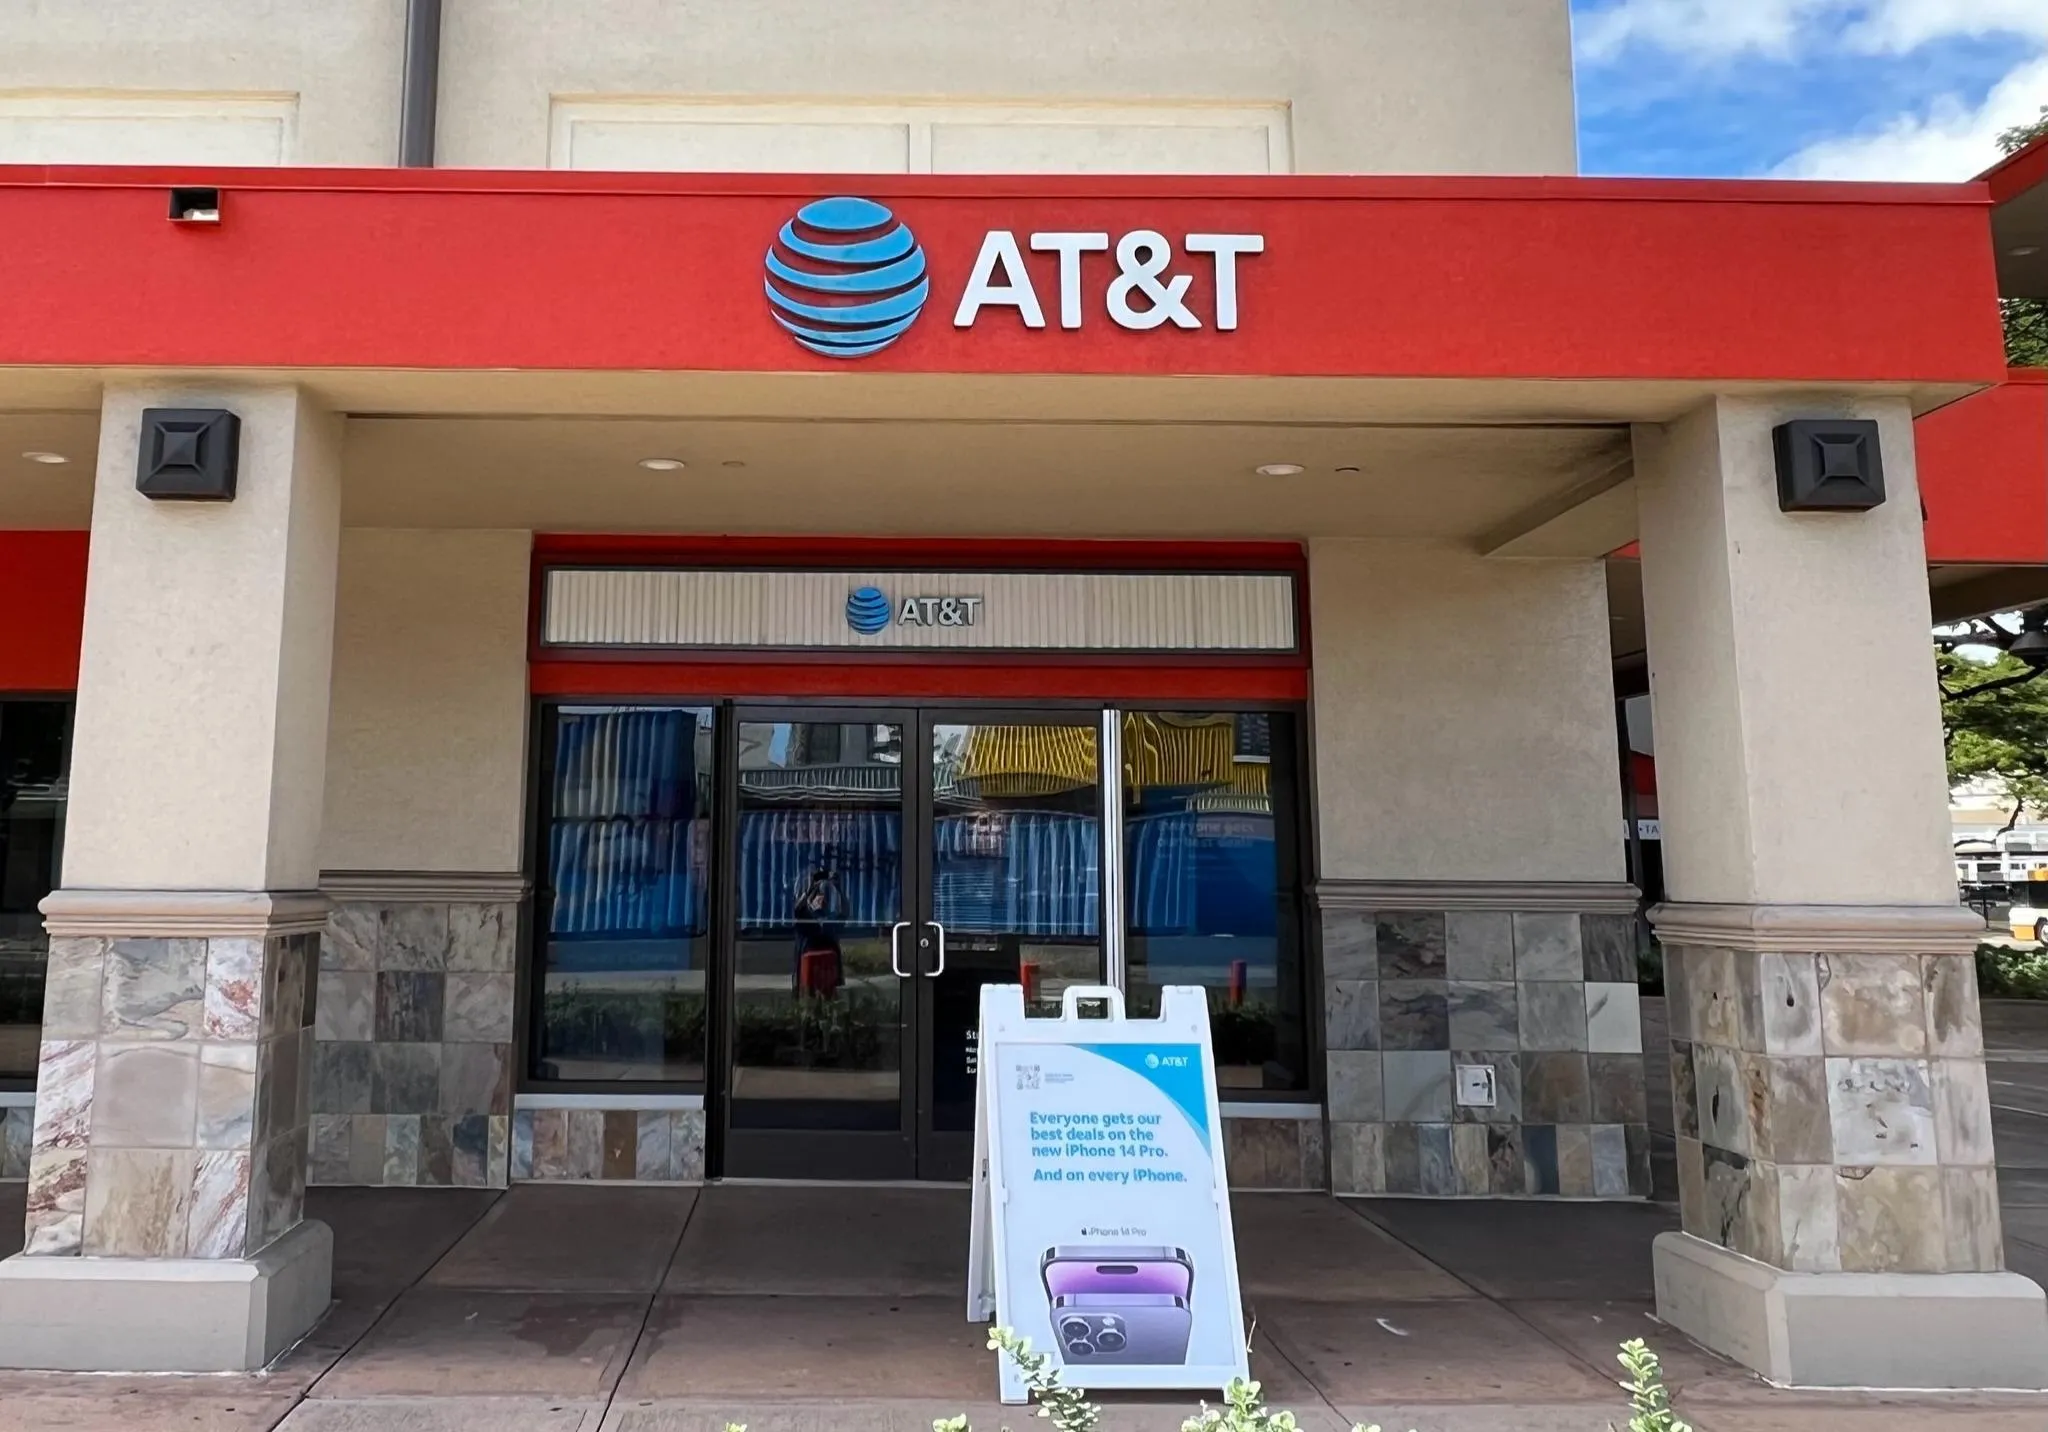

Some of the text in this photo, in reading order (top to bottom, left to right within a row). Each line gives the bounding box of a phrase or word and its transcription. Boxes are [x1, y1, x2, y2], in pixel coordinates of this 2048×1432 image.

[954, 229, 1265, 332] AT&T
[897, 594, 982, 627] AT&T
[1162, 1056, 1189, 1068] AT&T
[1030, 1111, 1161, 1127] Everyone gets our
[1031, 1128, 1154, 1140] best deals on the
[1032, 1144, 1169, 1157] new iPhone 14 Pro.
[1034, 1169, 1187, 1184] And on every iPhone.
